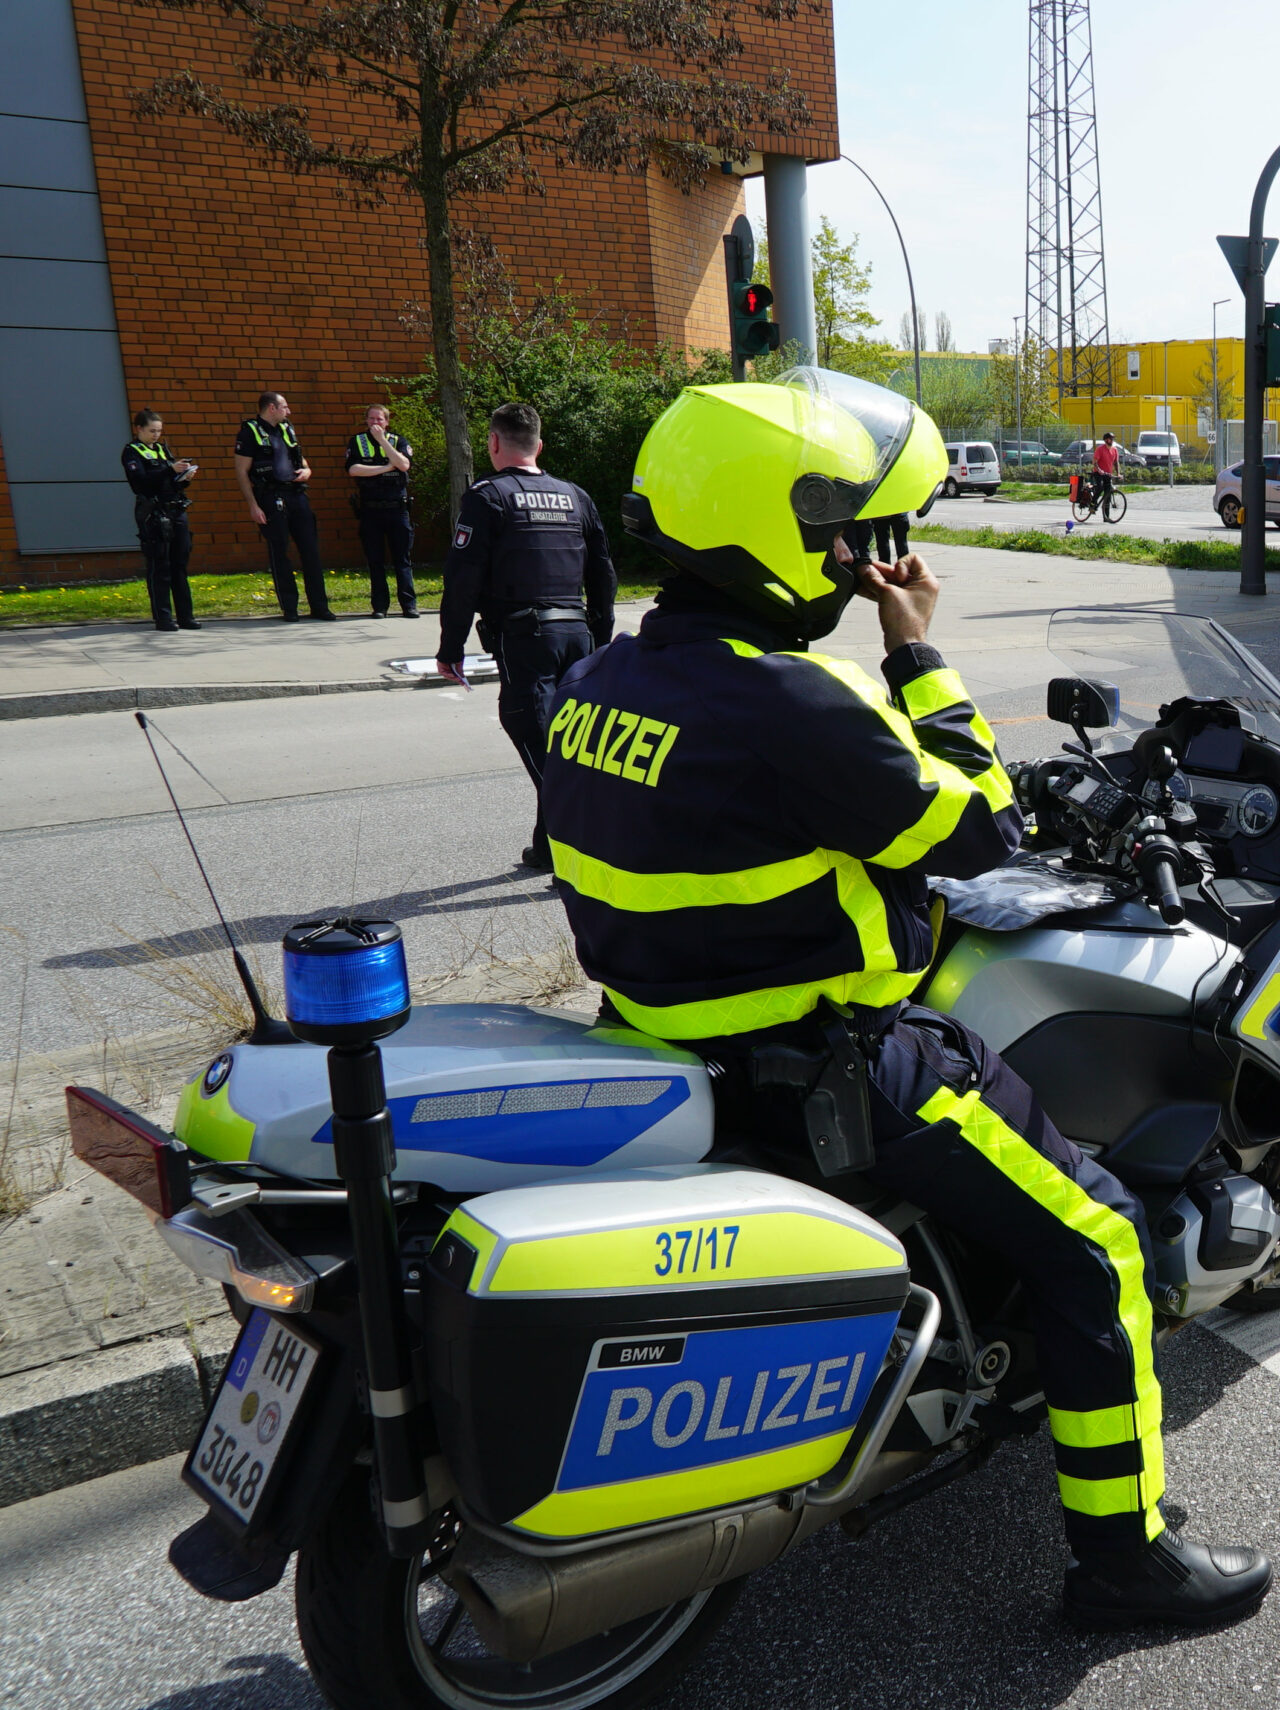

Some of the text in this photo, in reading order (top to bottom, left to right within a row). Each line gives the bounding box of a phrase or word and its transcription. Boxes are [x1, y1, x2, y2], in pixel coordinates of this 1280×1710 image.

[514, 492, 574, 510] POLIZEI
[546, 697, 681, 788] POLIZEI
[654, 1225, 740, 1277] 37/17
[235, 1357, 248, 1378] D
[263, 1327, 306, 1394] HH
[619, 1345, 666, 1363] BMW
[595, 1351, 867, 1457] POLIZEI
